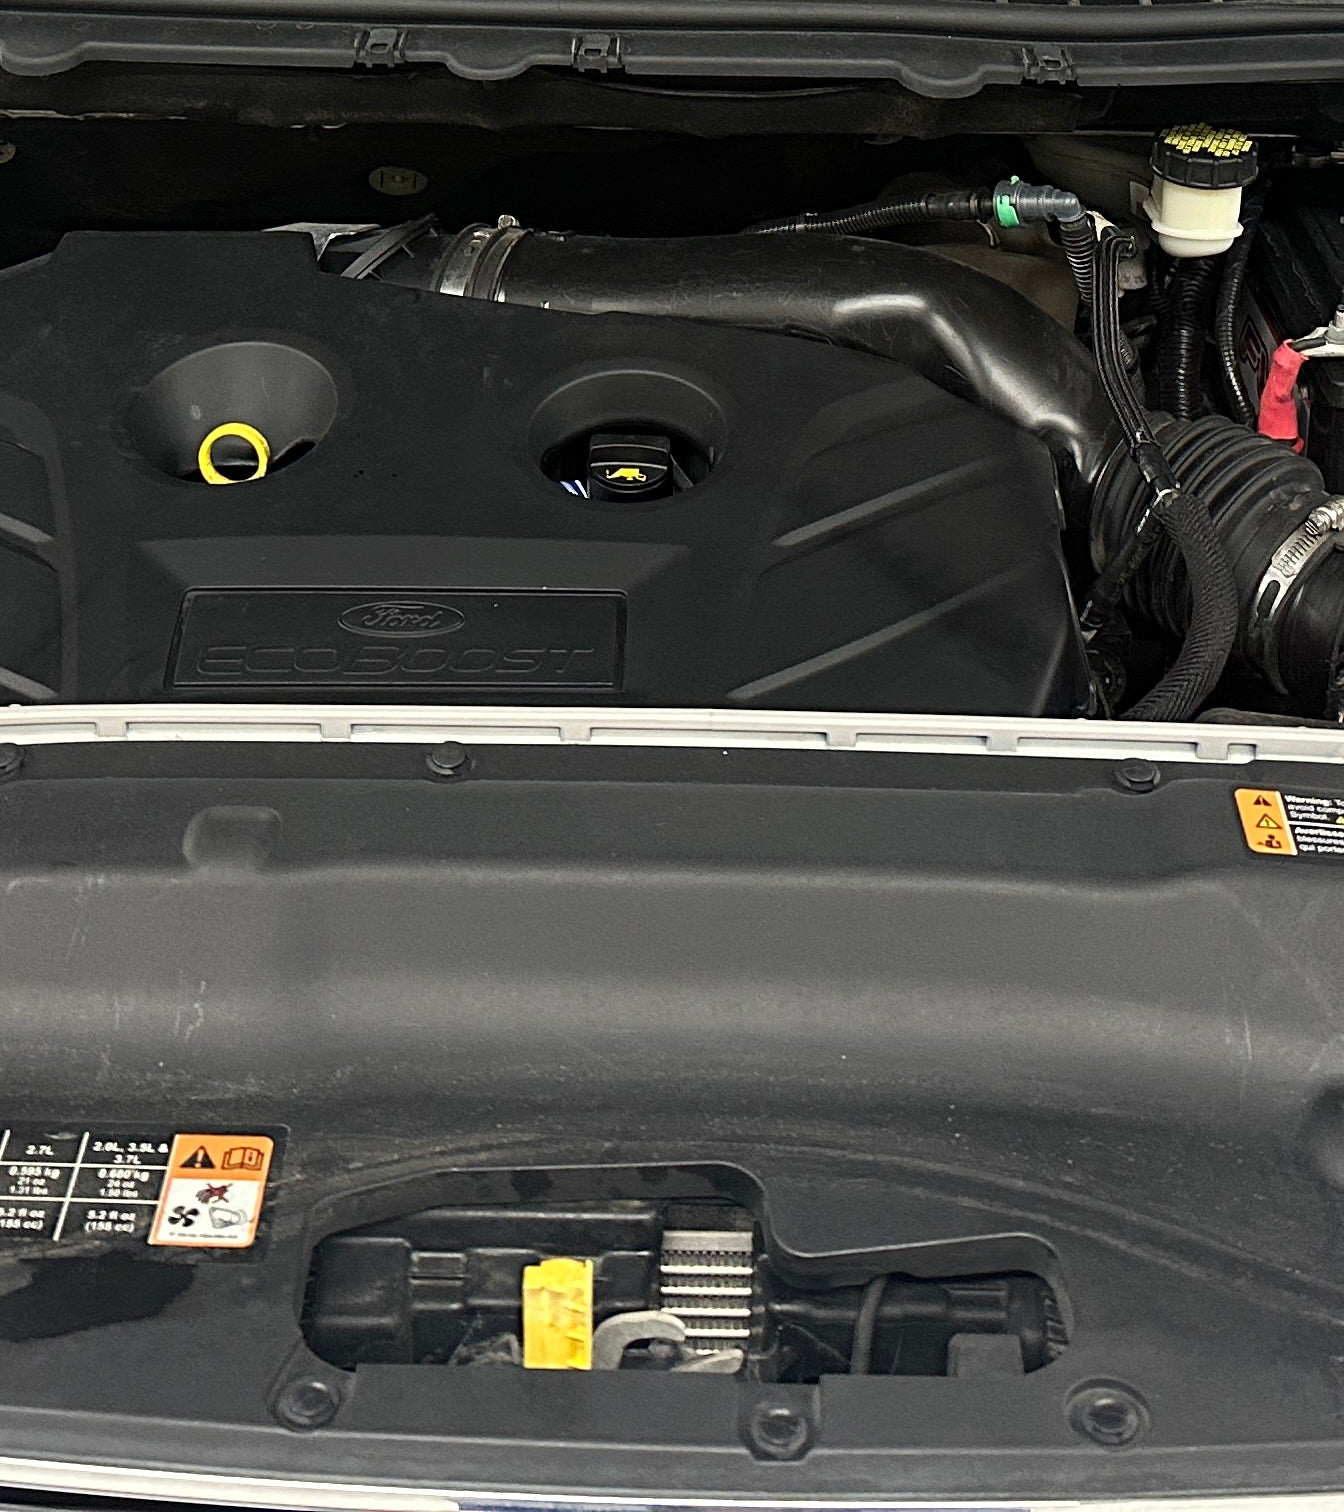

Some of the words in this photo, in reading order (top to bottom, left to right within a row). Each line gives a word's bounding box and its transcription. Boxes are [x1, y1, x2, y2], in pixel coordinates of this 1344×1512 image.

[361, 604, 443, 627] Ford
[197, 646, 595, 675] ECOBOOST
[1285, 796, 1332, 806] Warning:
[1288, 804, 1315, 812] avoid
[1297, 836, 1344, 845] blessures
[26, 1145, 54, 1156] 2.7L
[128, 1143, 155, 1153] 3.5L
[158, 1143, 168, 1153] &
[114, 1155, 141, 1164] 3.7L
[44, 1167, 60, 1179] kg
[134, 1170, 150, 1182] kg
